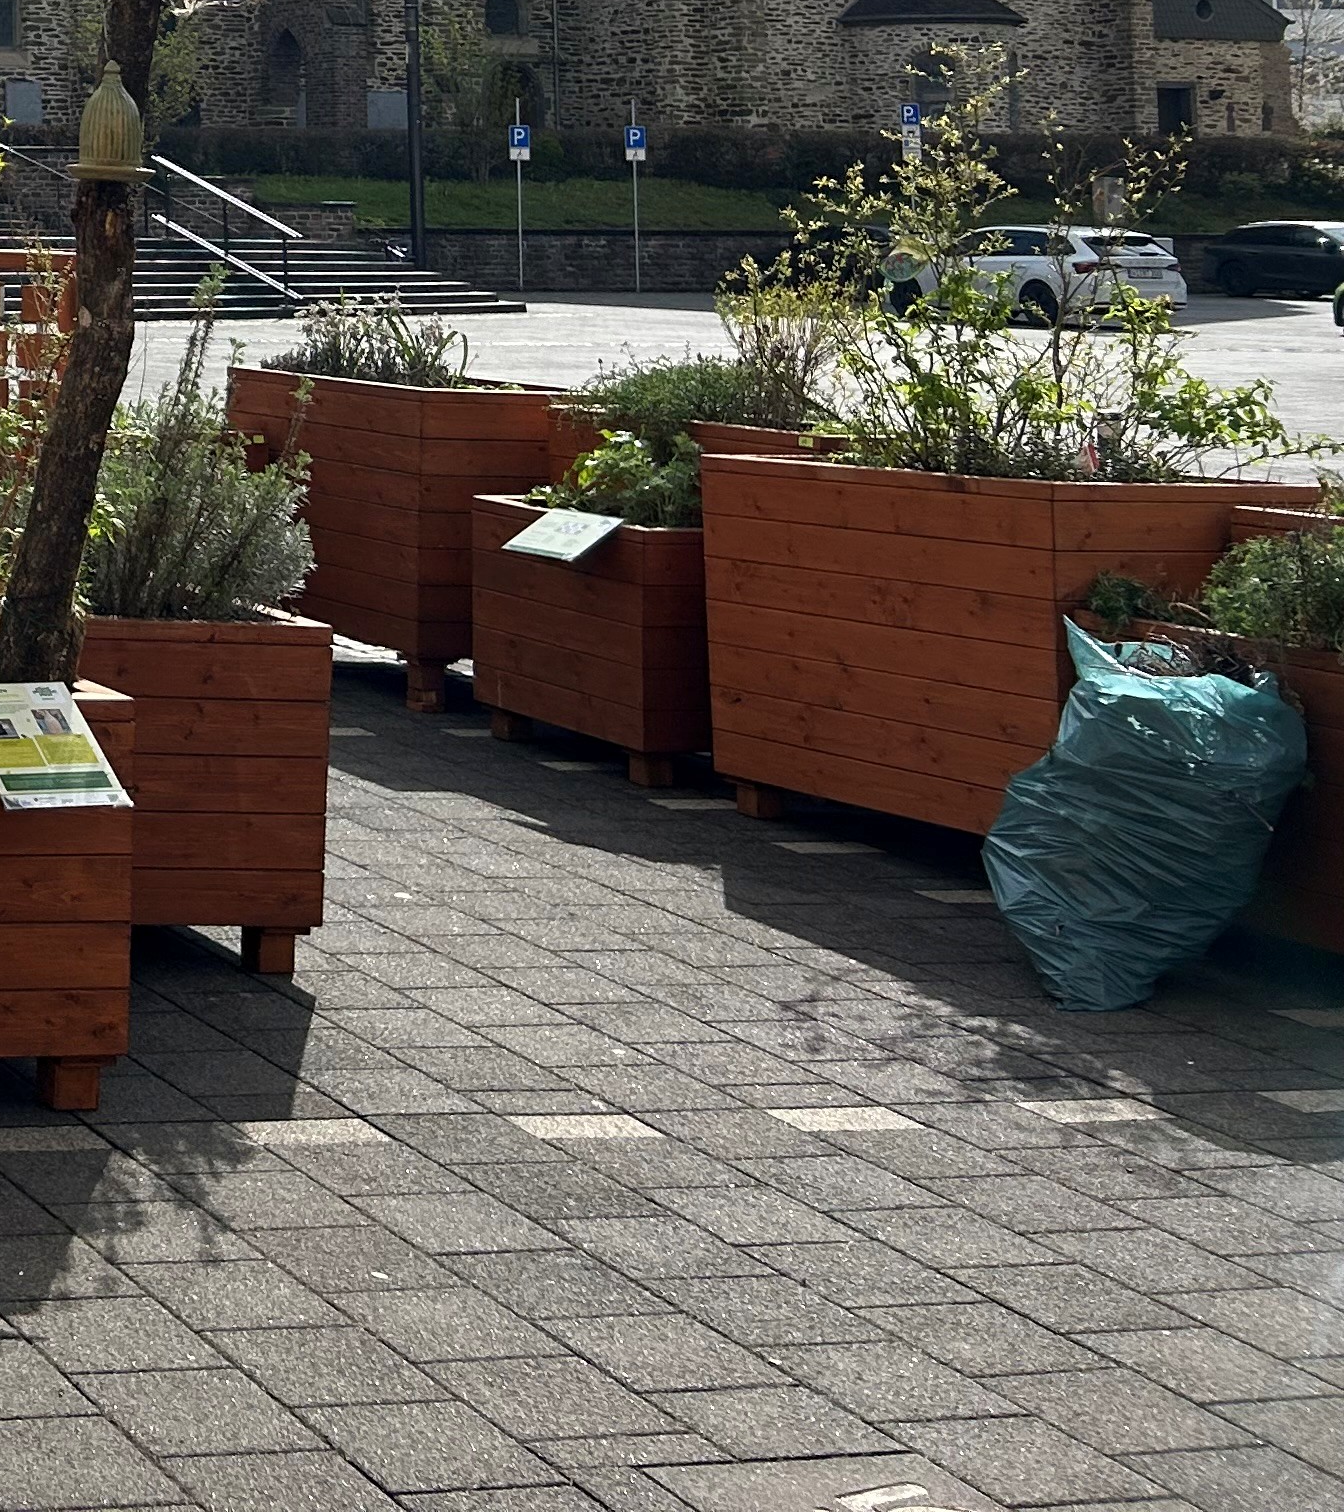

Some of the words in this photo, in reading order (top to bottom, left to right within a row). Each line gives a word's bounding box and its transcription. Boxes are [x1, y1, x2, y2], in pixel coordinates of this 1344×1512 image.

[903, 106, 914, 123] P
[513, 128, 525, 145] P
[629, 129, 641, 146] P
